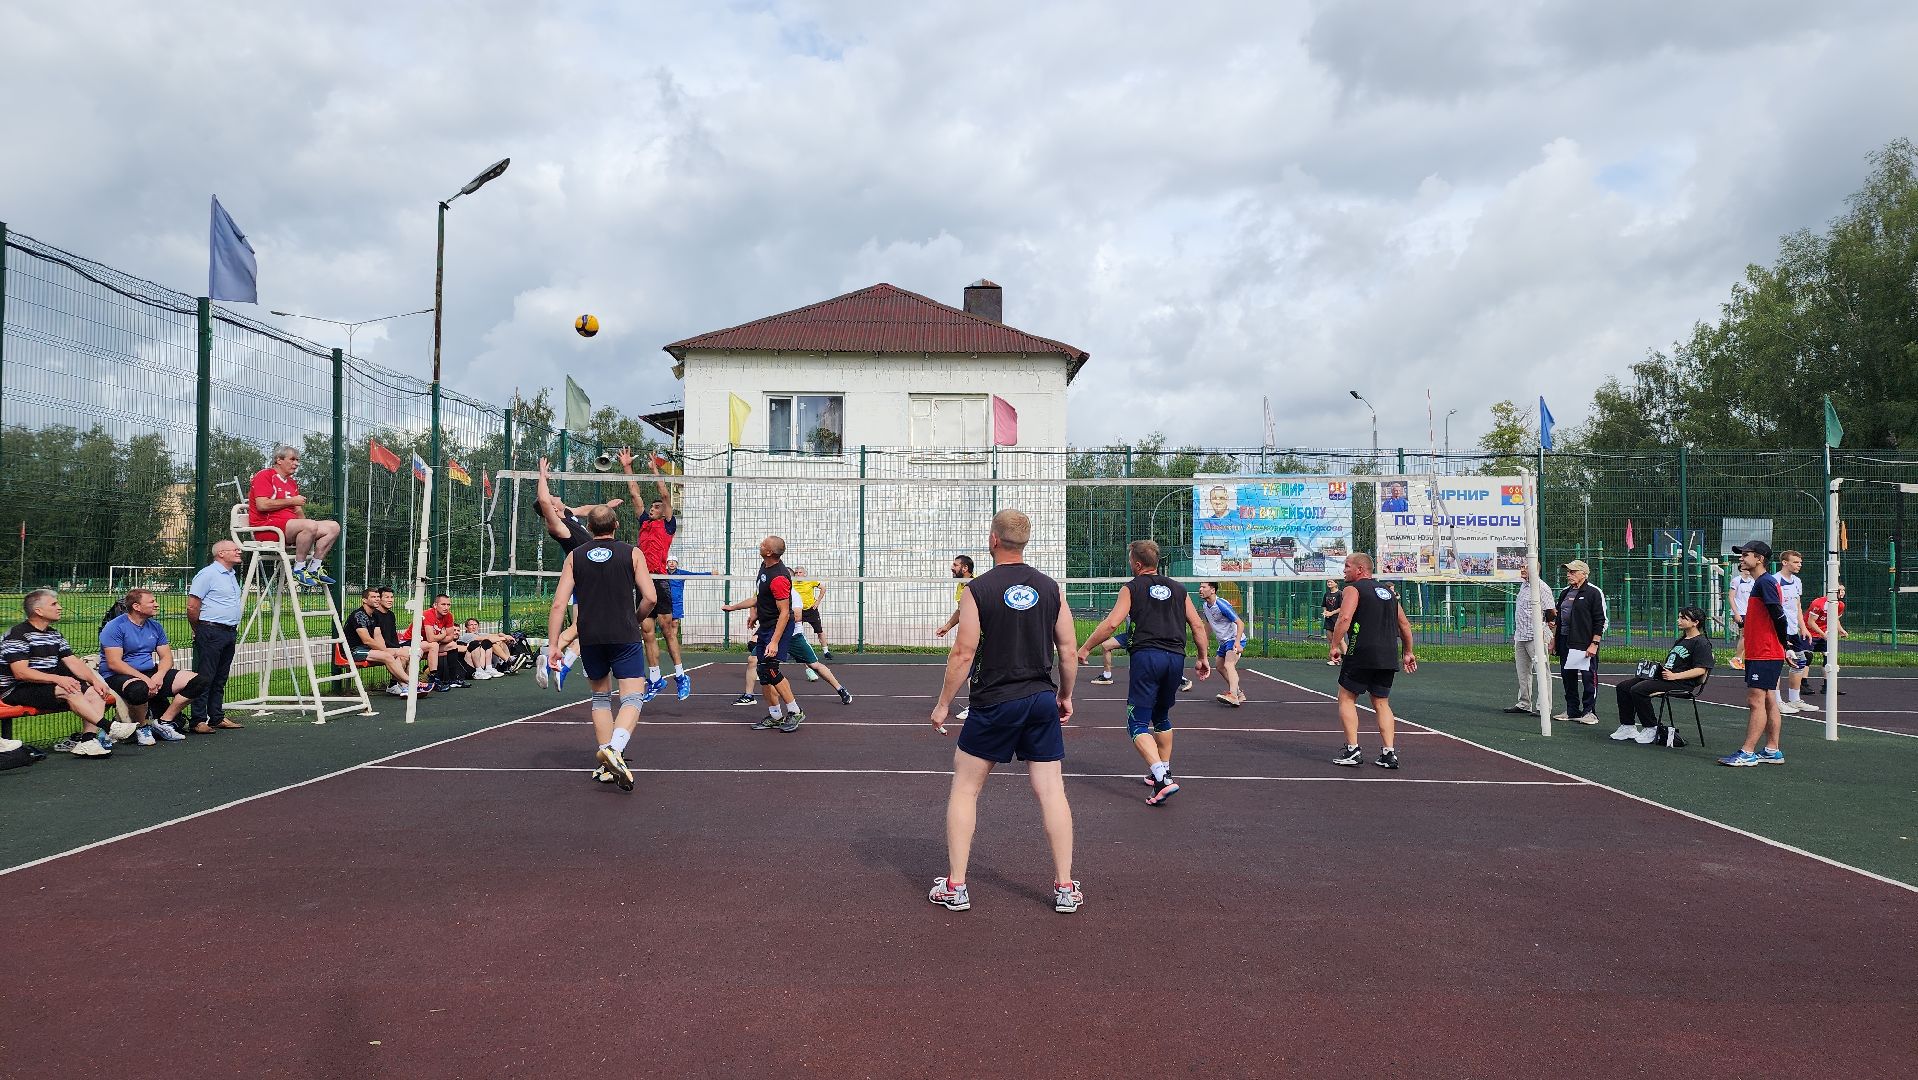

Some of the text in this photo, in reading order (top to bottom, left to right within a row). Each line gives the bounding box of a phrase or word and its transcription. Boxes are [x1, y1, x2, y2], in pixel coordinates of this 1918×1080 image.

[1262, 482, 1305, 497] ТУРНИР
[1239, 504, 1327, 520] ПО ВОЛЕЙБОЛУ
[1394, 515, 1416, 526] ПО
